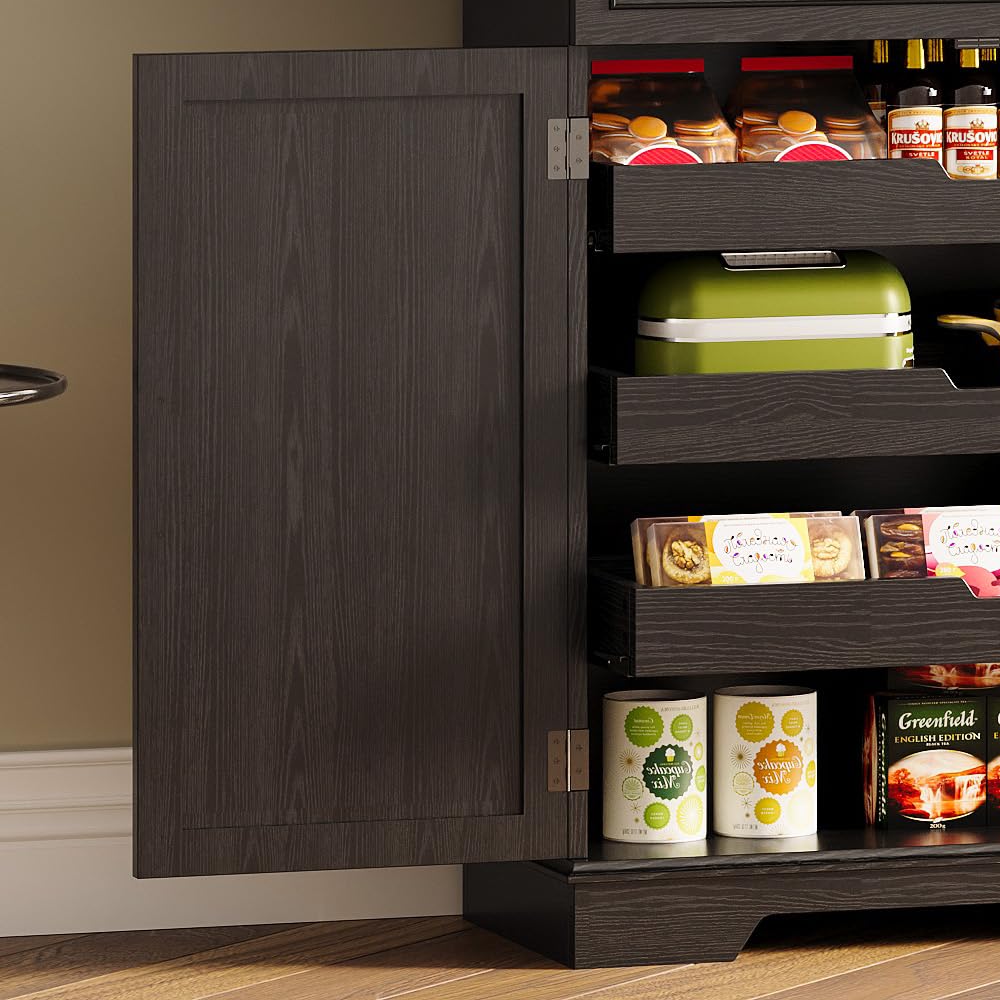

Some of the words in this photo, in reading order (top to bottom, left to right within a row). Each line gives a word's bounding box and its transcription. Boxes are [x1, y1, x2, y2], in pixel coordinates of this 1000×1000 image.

[898, 709, 975, 730] Greenfield
[894, 734, 936, 743] ENGLISH
[938, 732, 981, 742] EDITION
